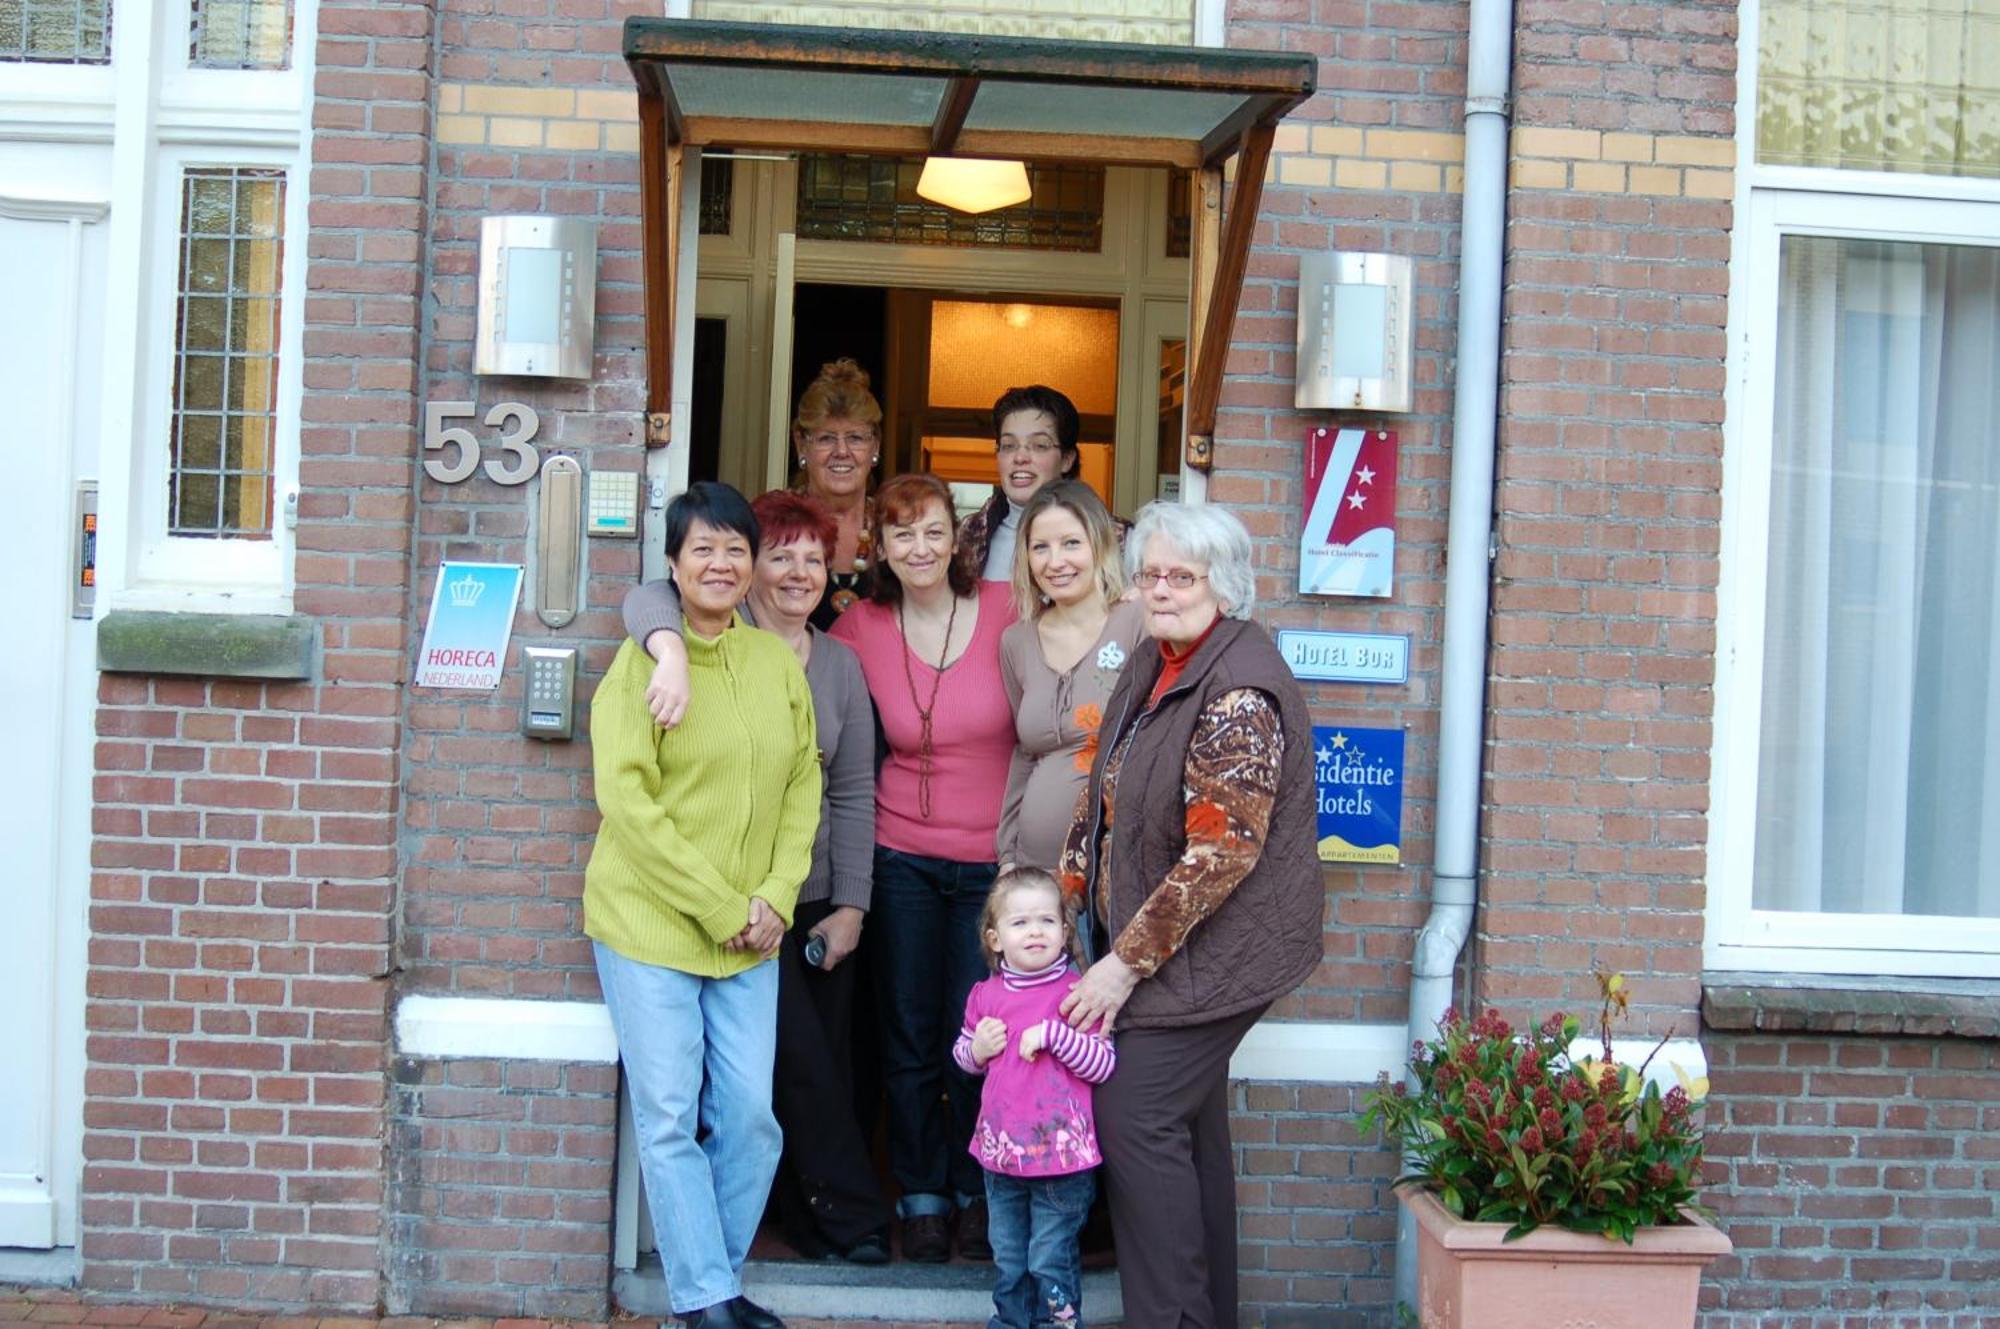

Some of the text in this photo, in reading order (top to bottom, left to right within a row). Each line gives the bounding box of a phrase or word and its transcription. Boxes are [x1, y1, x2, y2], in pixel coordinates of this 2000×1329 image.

[424, 400, 541, 485] 53
[428, 648, 496, 668] HORECA
[424, 672, 494, 687] NEDERLAND
